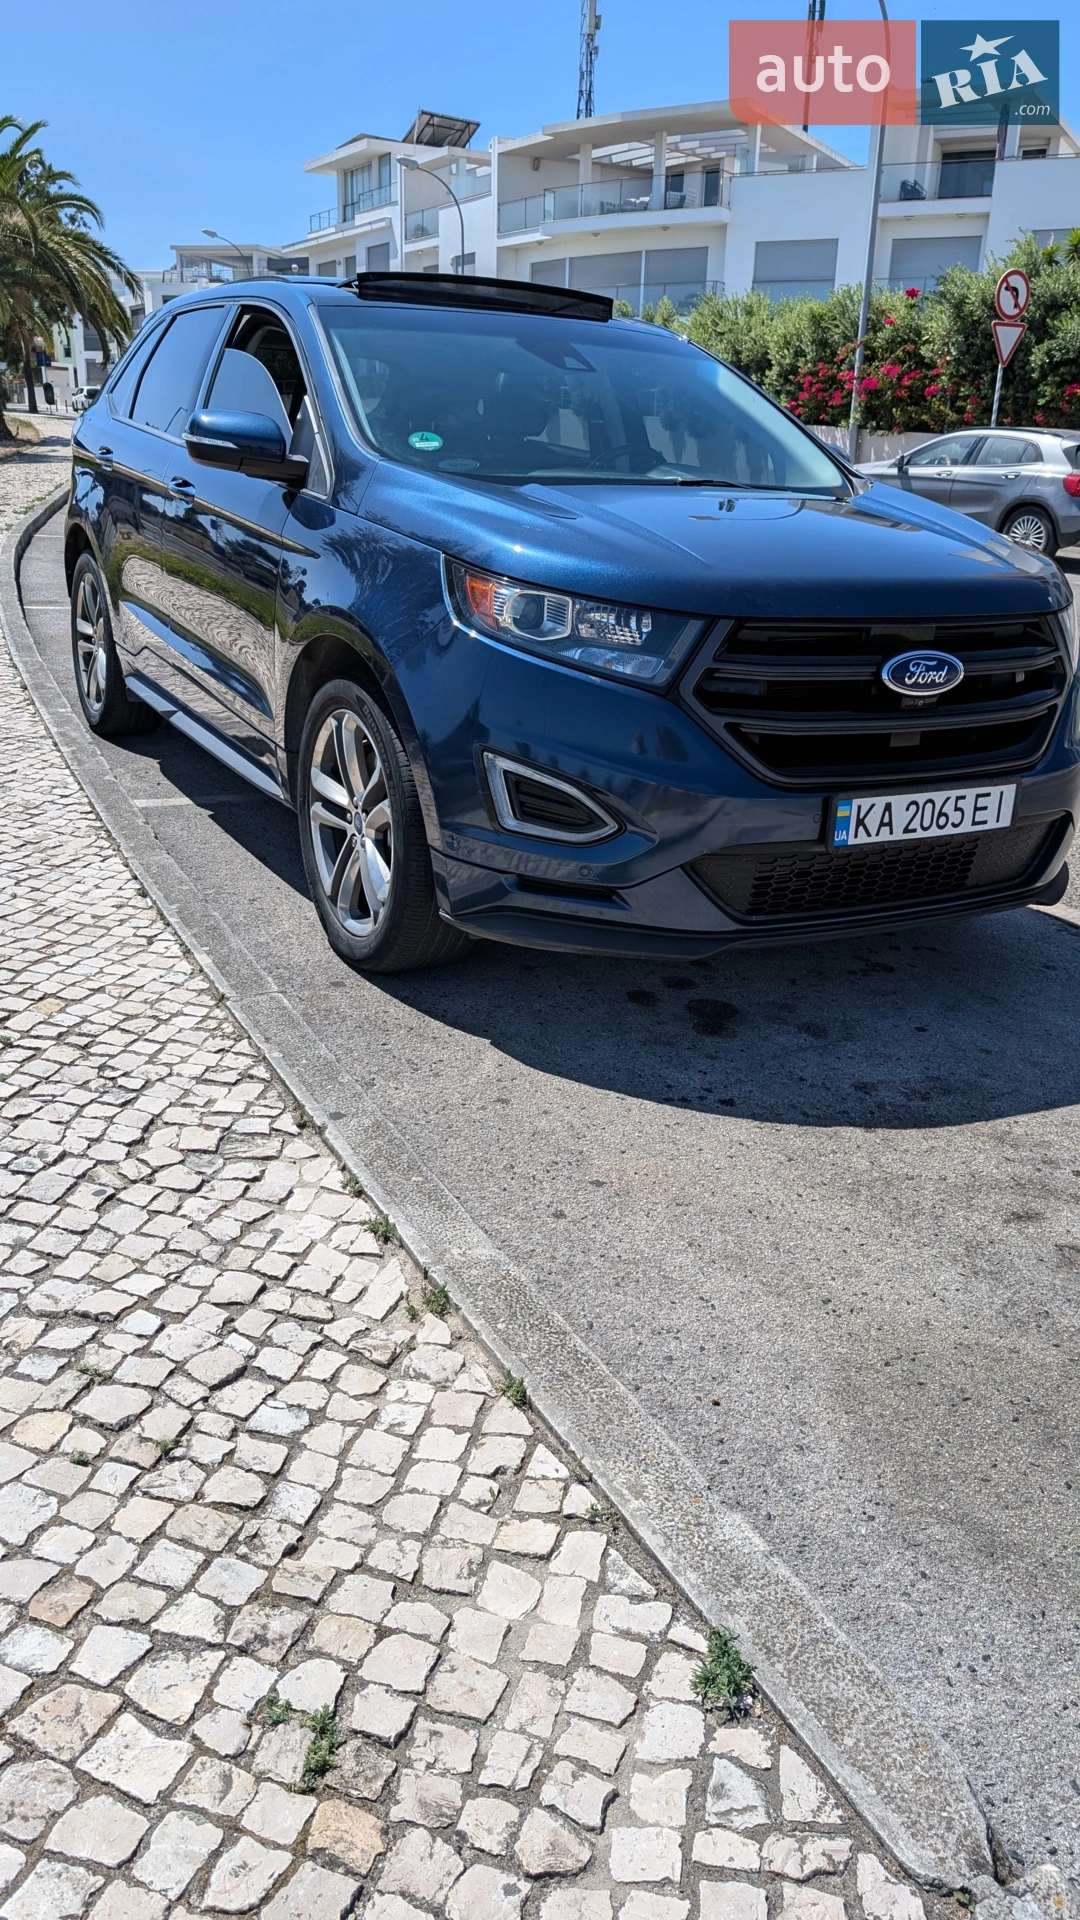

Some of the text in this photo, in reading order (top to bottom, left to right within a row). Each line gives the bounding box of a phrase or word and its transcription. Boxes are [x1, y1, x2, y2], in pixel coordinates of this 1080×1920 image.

[904, 660, 949, 685] Ford
[853, 802, 894, 839] KA
[902, 795, 967, 835] 2065
[834, 830, 847, 842] UA
